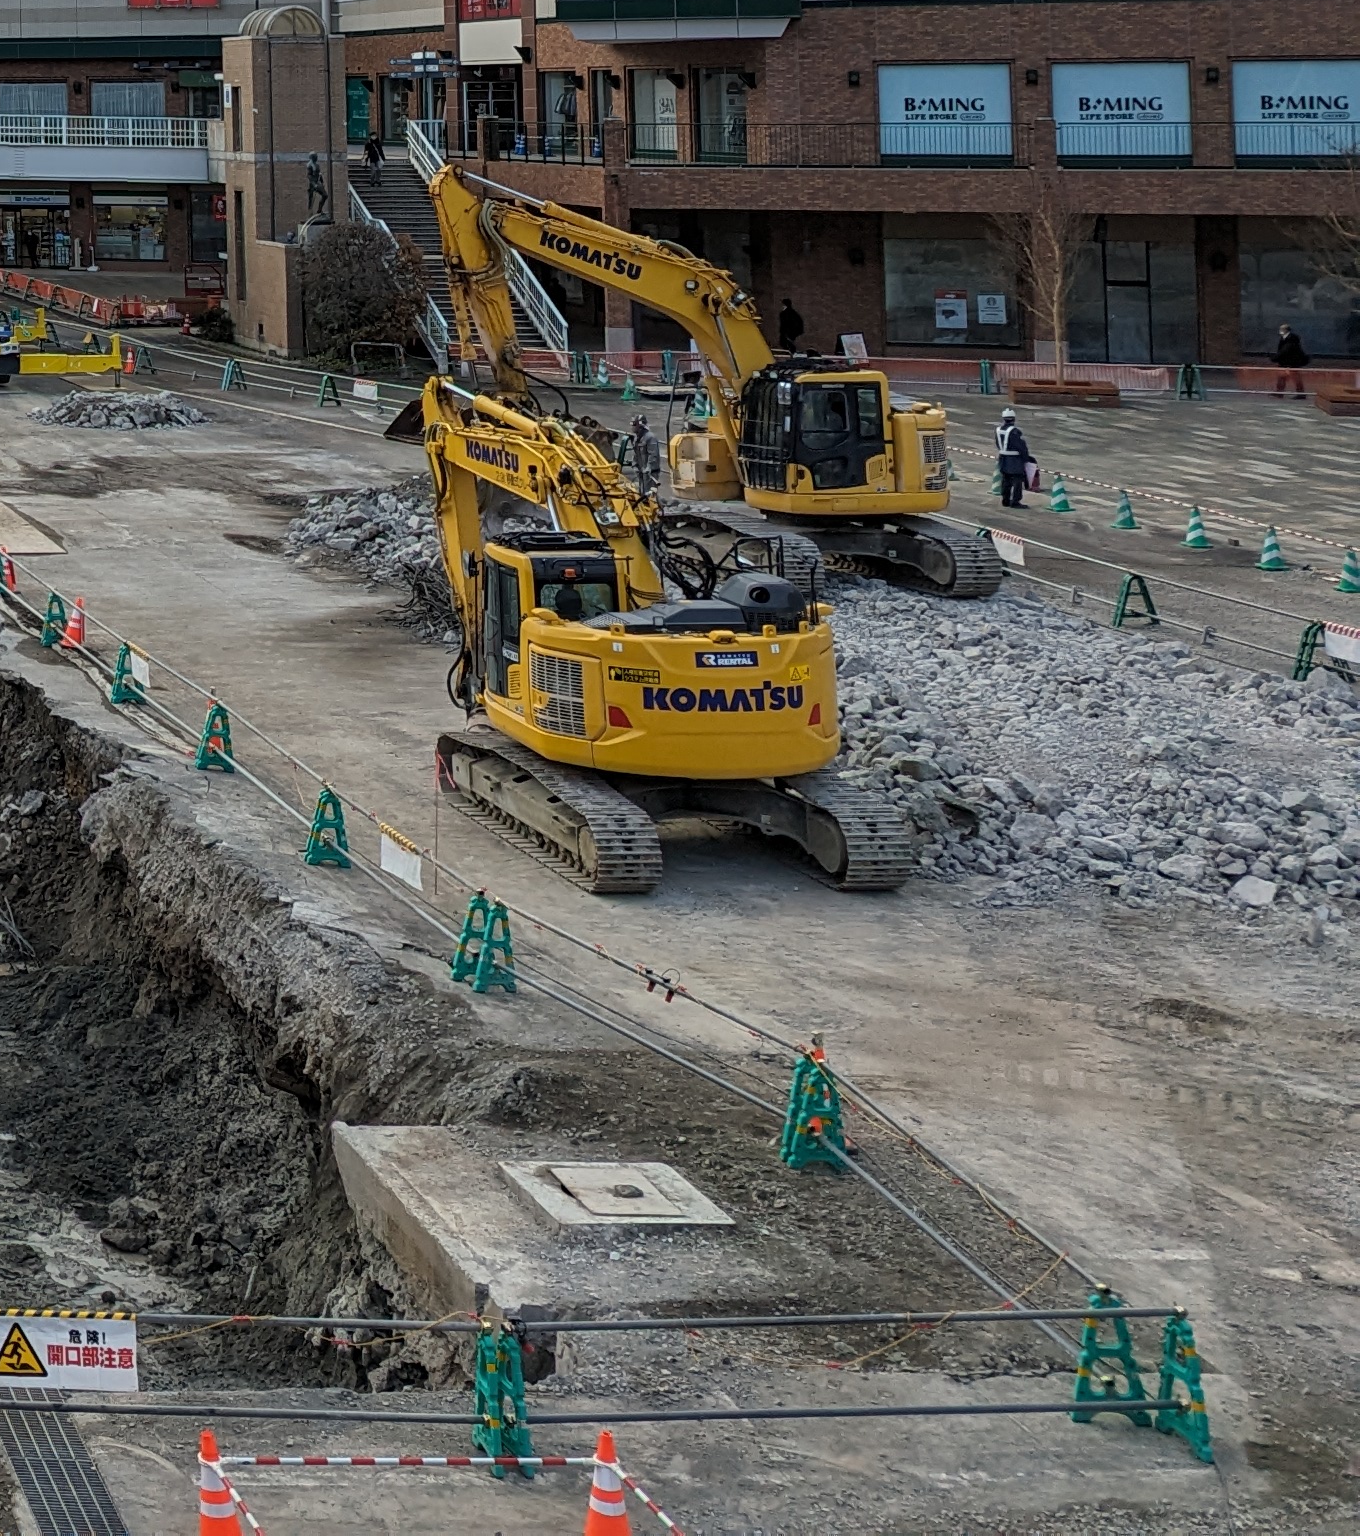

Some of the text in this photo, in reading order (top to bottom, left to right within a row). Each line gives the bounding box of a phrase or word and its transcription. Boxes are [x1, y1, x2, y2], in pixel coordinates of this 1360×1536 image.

[1261, 112, 1285, 120] LIFE
[539, 230, 642, 281] KOMATSU
[466, 438, 519, 473] KOMATSU
[643, 681, 803, 712] KOMATSU
[68, 1329, 106, 1345] 危険!
[46, 1344, 135, 1368] 開口部注意
